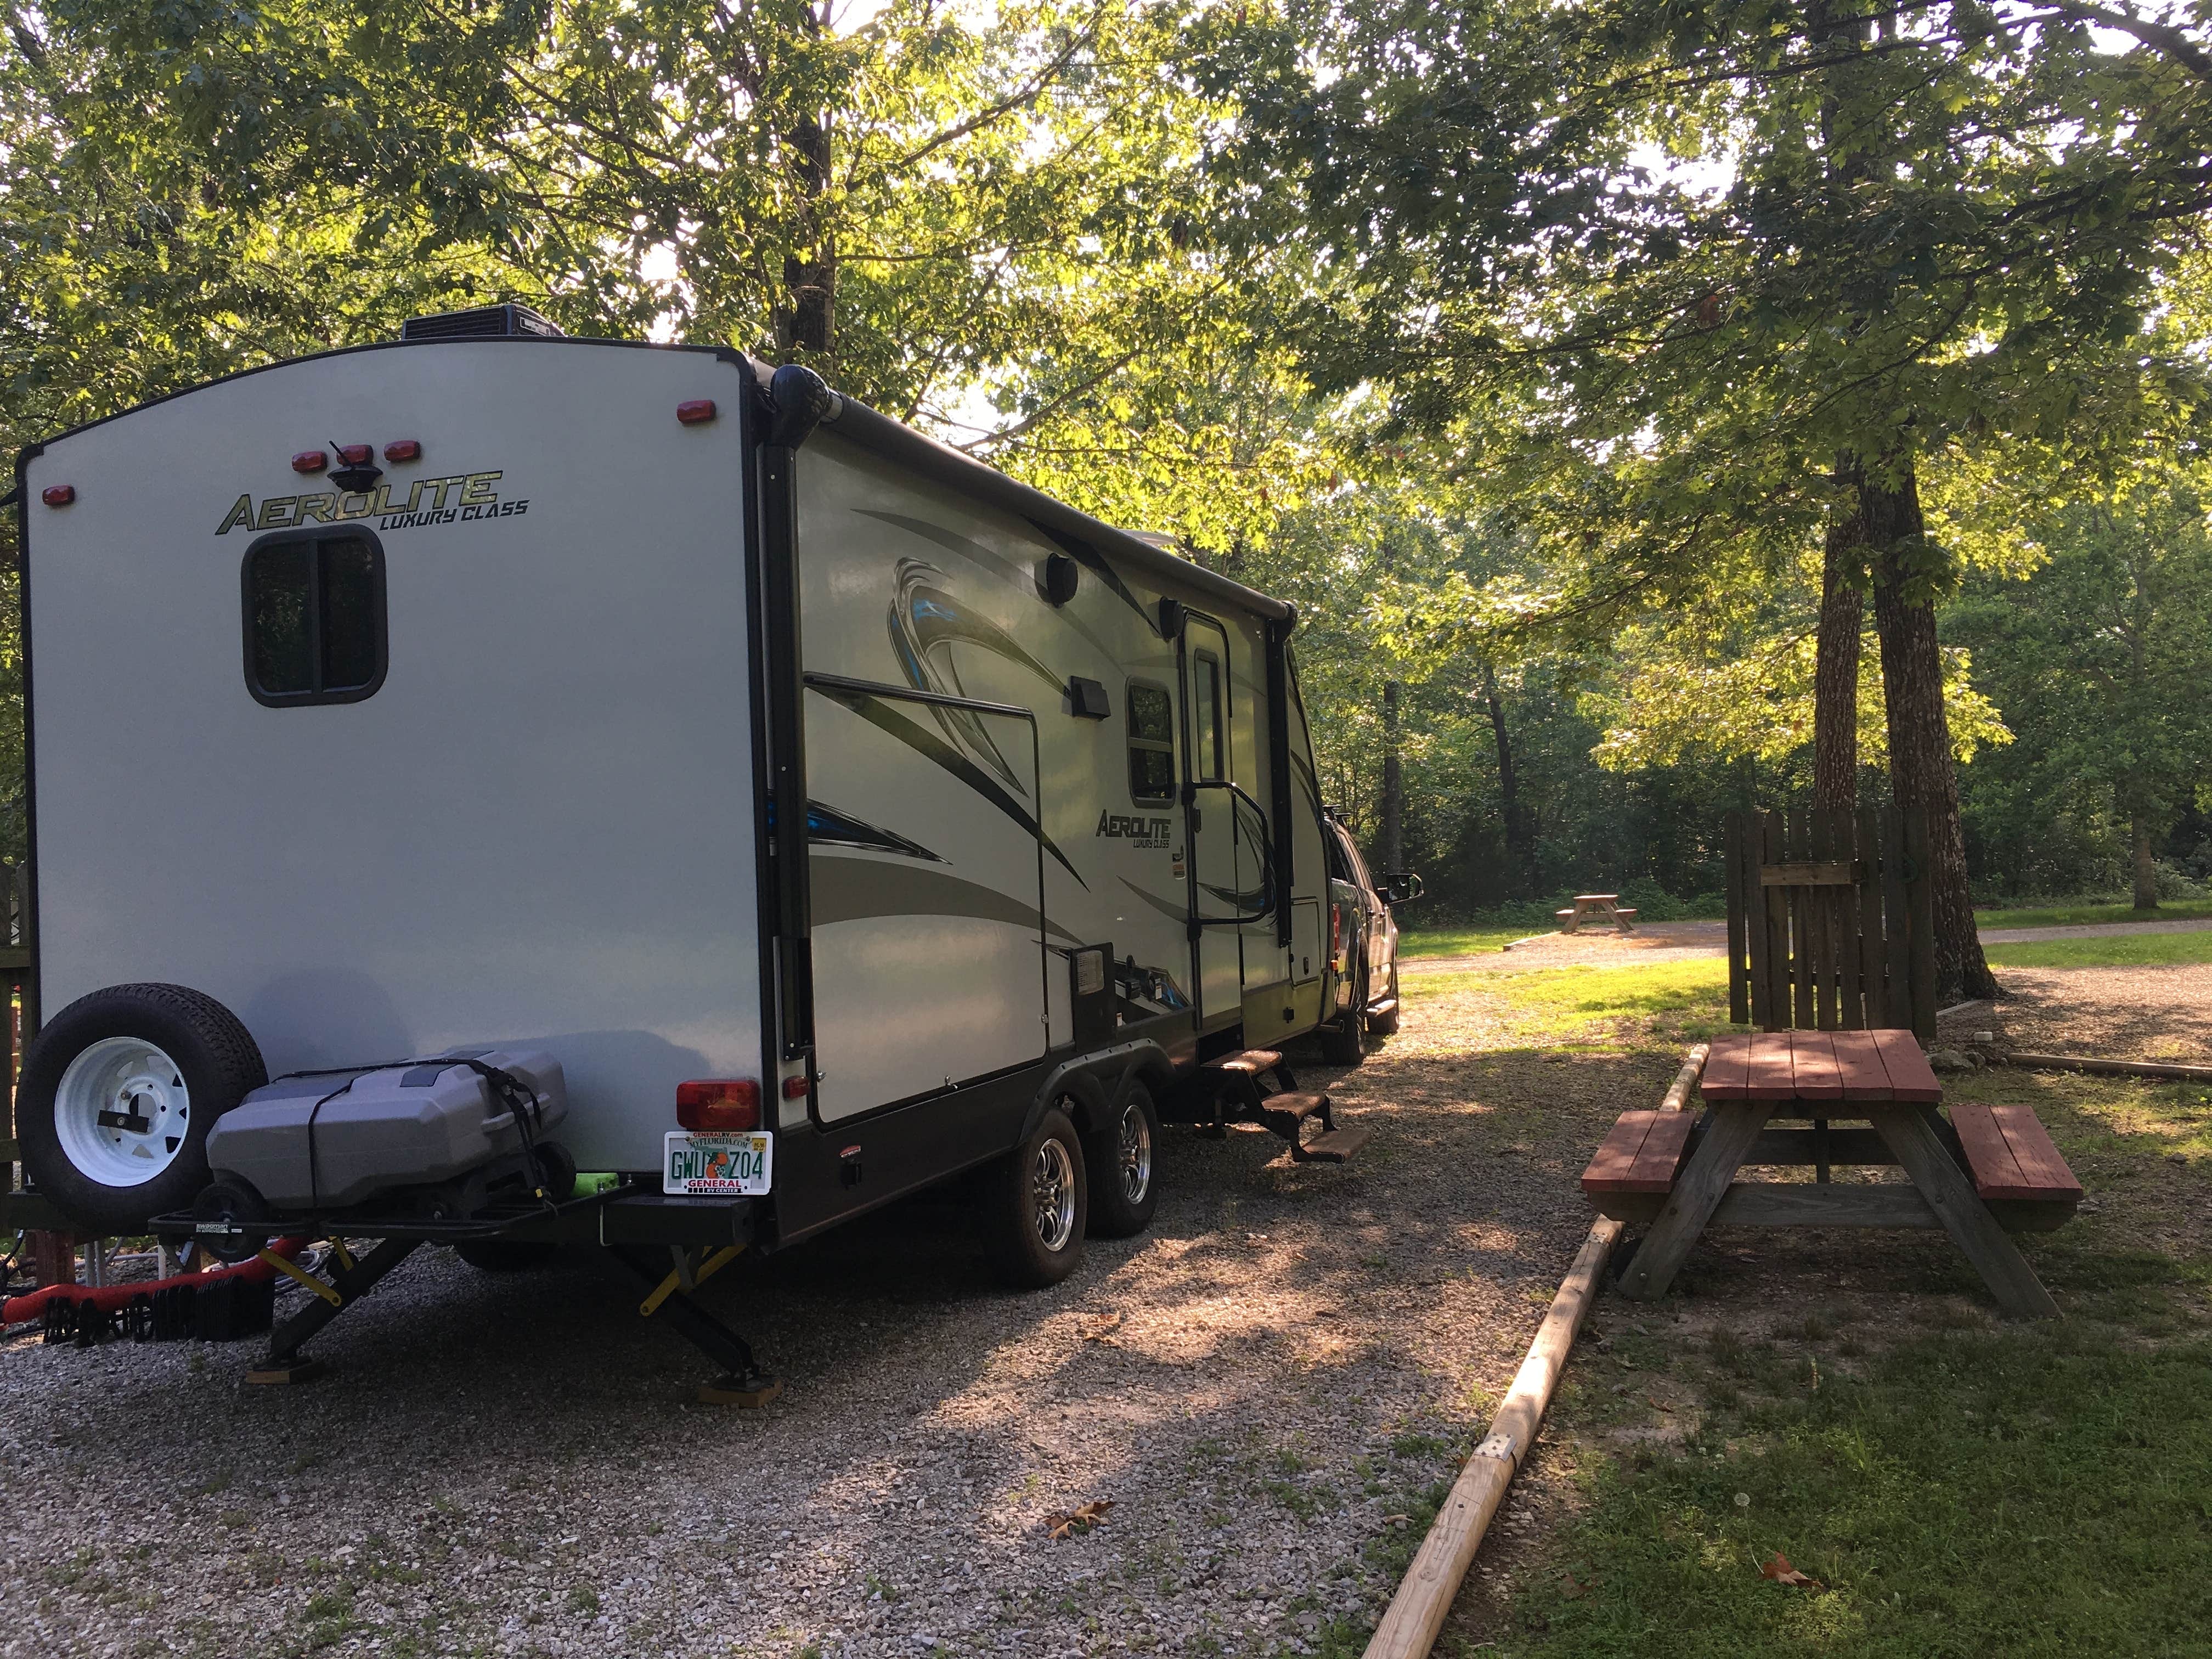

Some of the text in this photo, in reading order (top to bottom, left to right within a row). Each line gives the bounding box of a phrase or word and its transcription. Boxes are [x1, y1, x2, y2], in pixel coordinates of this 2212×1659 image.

[215, 470, 503, 535] AEROLITE
[380, 499, 530, 531] LUXURY CLASS
[1096, 809, 1171, 839] AEROLITE
[1133, 839, 1170, 849] LUXURY CLASS
